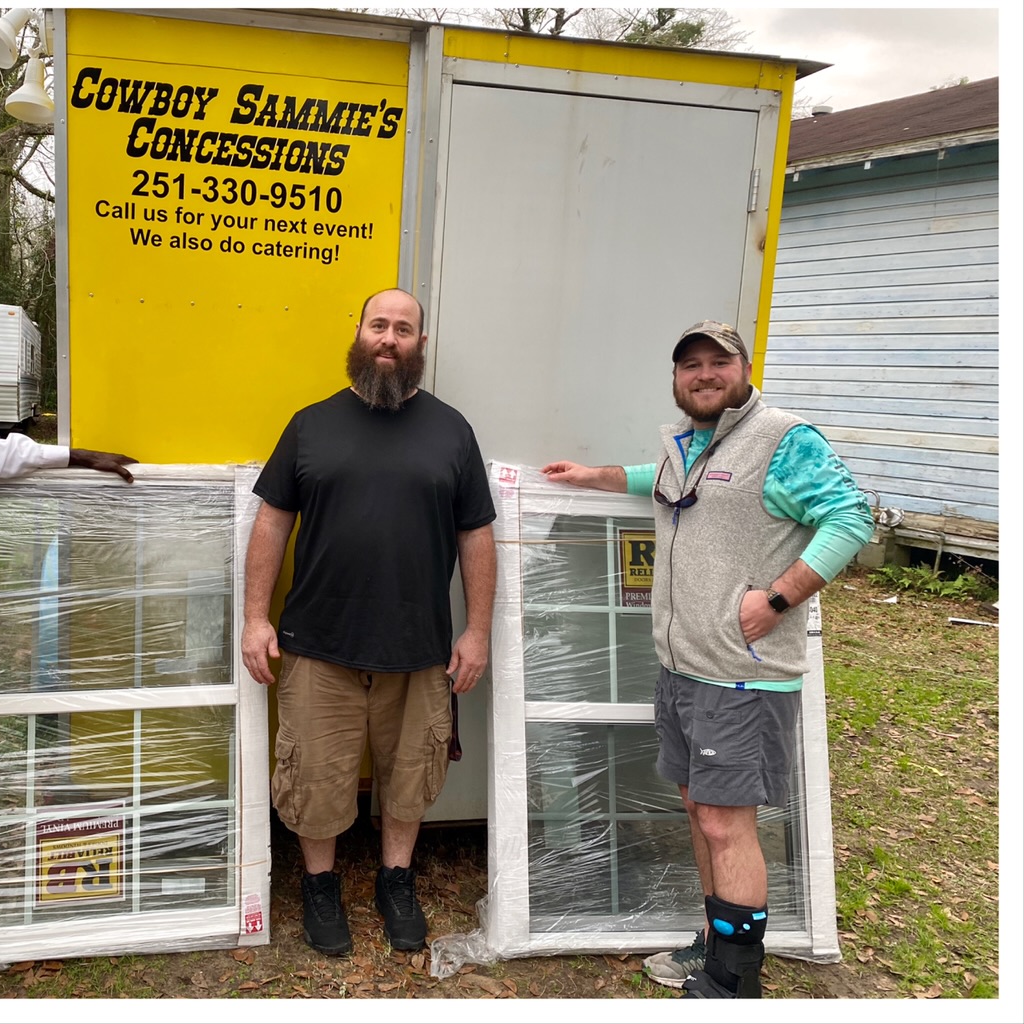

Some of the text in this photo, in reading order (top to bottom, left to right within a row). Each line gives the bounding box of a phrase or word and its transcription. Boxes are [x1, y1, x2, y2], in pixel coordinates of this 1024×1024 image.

[71, 67, 404, 139] COWBOY SAMMIE'S
[126, 116, 350, 176] CONCESSIONS
[131, 169, 342, 214] 251-330-9510
[95, 199, 374, 240] Call us for your next event!
[129, 227, 340, 265] We also do catering!
